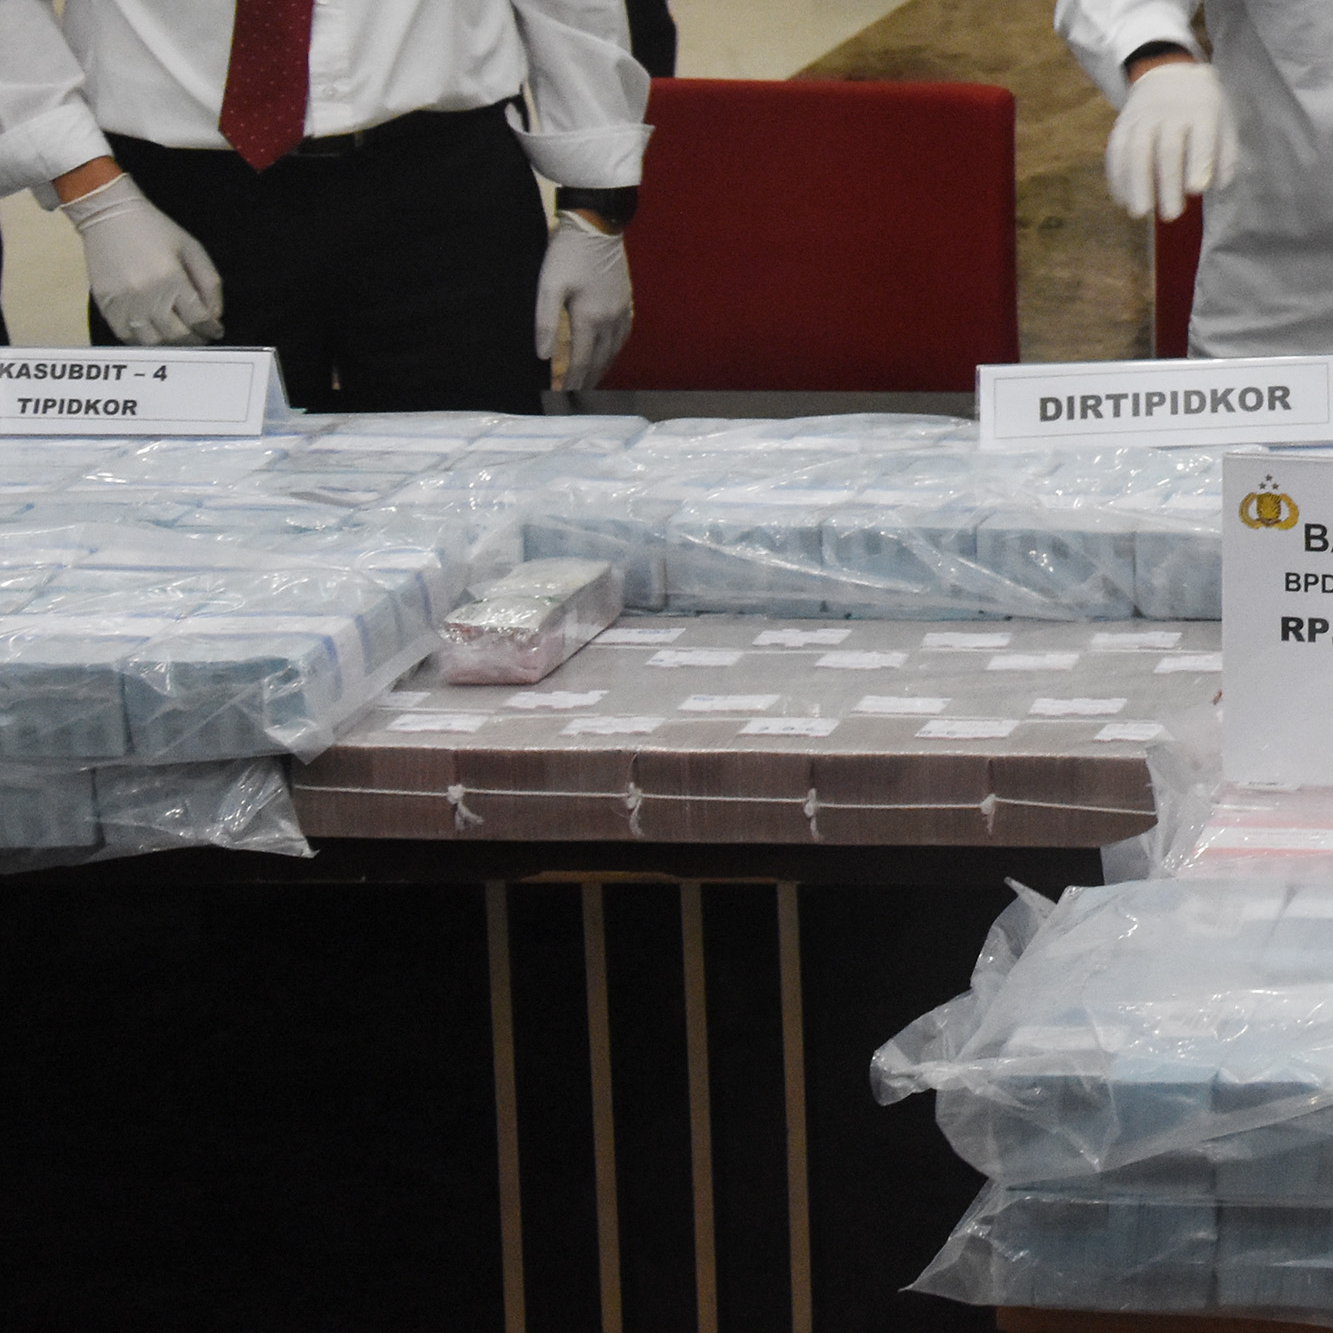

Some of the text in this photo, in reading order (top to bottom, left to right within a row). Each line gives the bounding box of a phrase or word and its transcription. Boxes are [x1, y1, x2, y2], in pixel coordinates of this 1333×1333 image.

[0, 362, 127, 381] KASUBDIT
[152, 365, 168, 382] 4
[17, 397, 138, 416] TIPIDKOR
[1038, 384, 1293, 423] DIRTIPIDKOR
